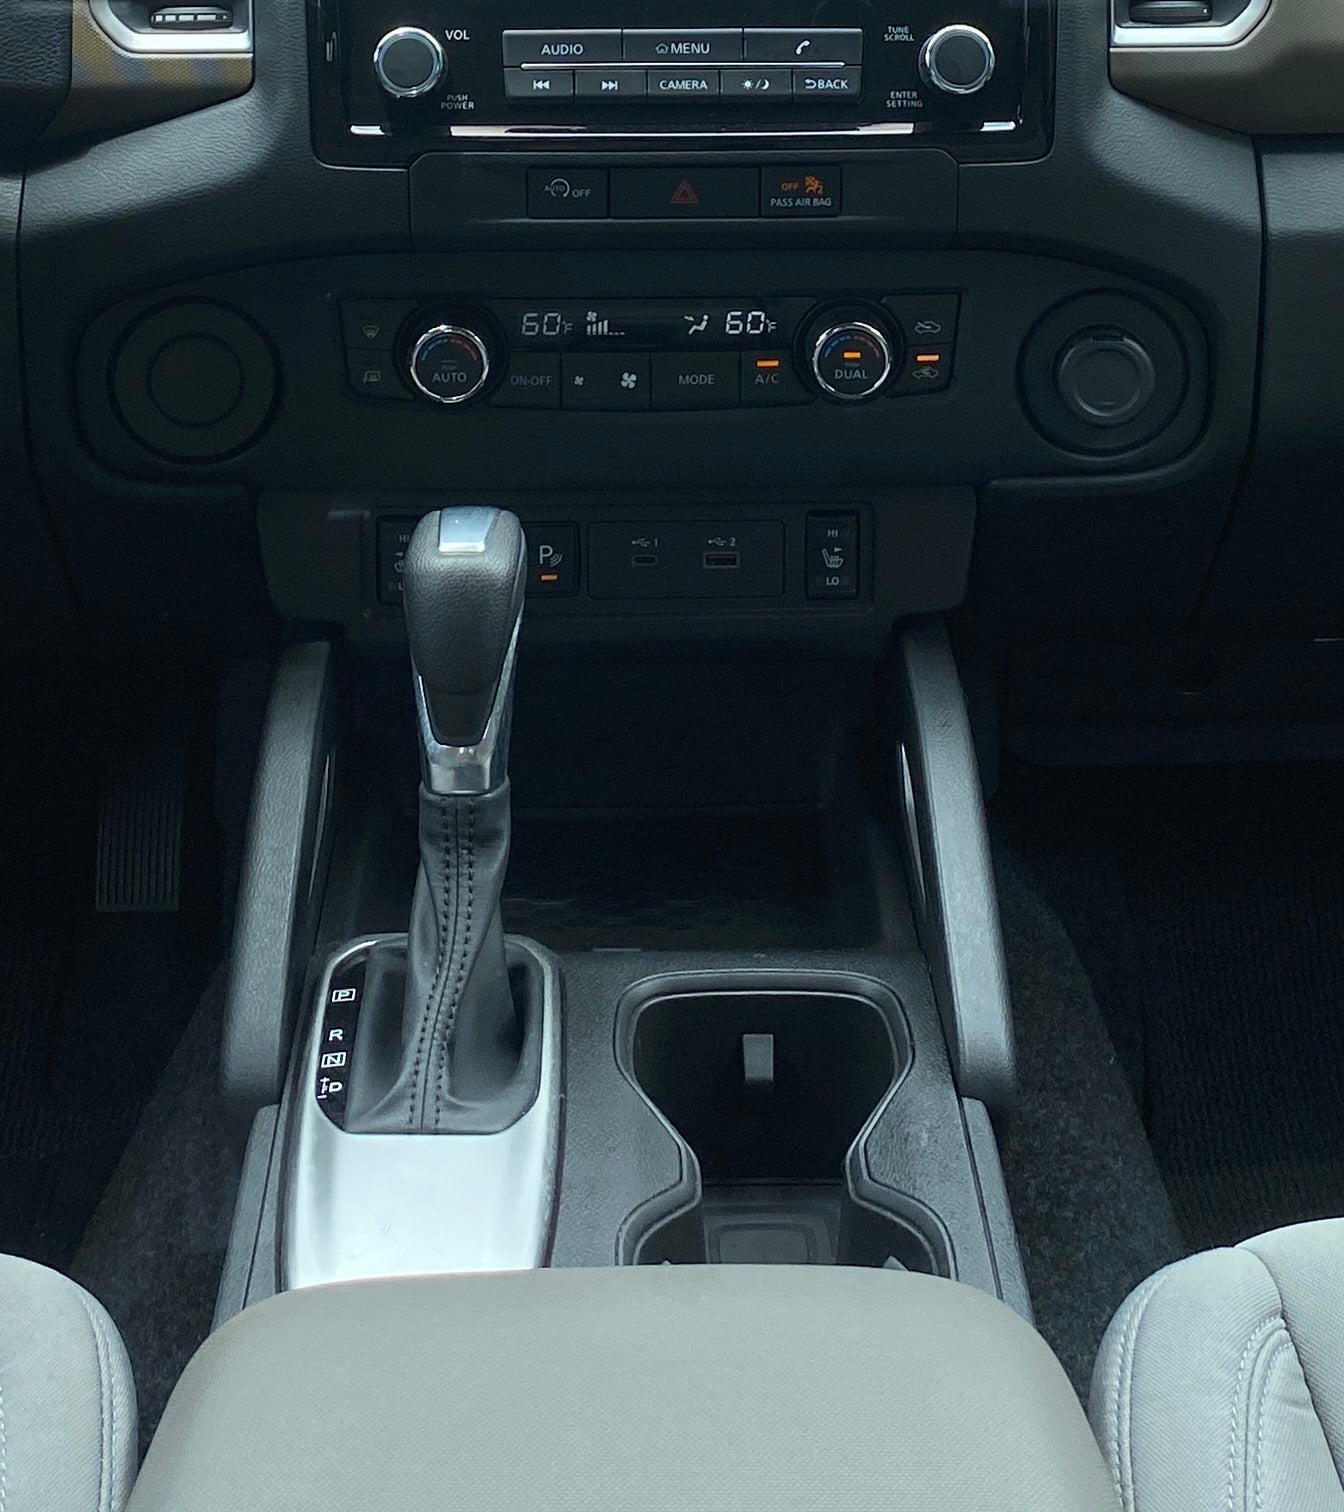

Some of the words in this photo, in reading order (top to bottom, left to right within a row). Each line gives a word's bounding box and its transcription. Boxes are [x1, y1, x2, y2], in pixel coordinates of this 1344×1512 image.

[445, 29, 471, 41] VOL
[887, 26, 909, 34] TUNE
[884, 34, 914, 42] SCROLL
[541, 44, 584, 55] AUDIO
[671, 43, 710, 54] MENU
[659, 80, 708, 90] CAMERA
[818, 79, 848, 89] BACK
[890, 91, 918, 99] ENTER
[441, 102, 475, 110] POWER
[886, 99, 923, 108] SETTING
[781, 182, 799, 191] OFF
[572, 188, 591, 198] OFF
[770, 197, 793, 207] PASS
[795, 197, 812, 207] AIR
[813, 197, 832, 207] BAG
[431, 371, 468, 384] AUTO
[678, 373, 716, 385] MODE
[754, 372, 780, 385] A/C
[834, 368, 869, 380] DUAL
[827, 529, 840, 538] HI
[729, 537, 737, 547] 2
[539, 544, 553, 565] P
[825, 576, 840, 586] LO
[329, 1028, 343, 1041] R
[328, 1081, 343, 1092] D
